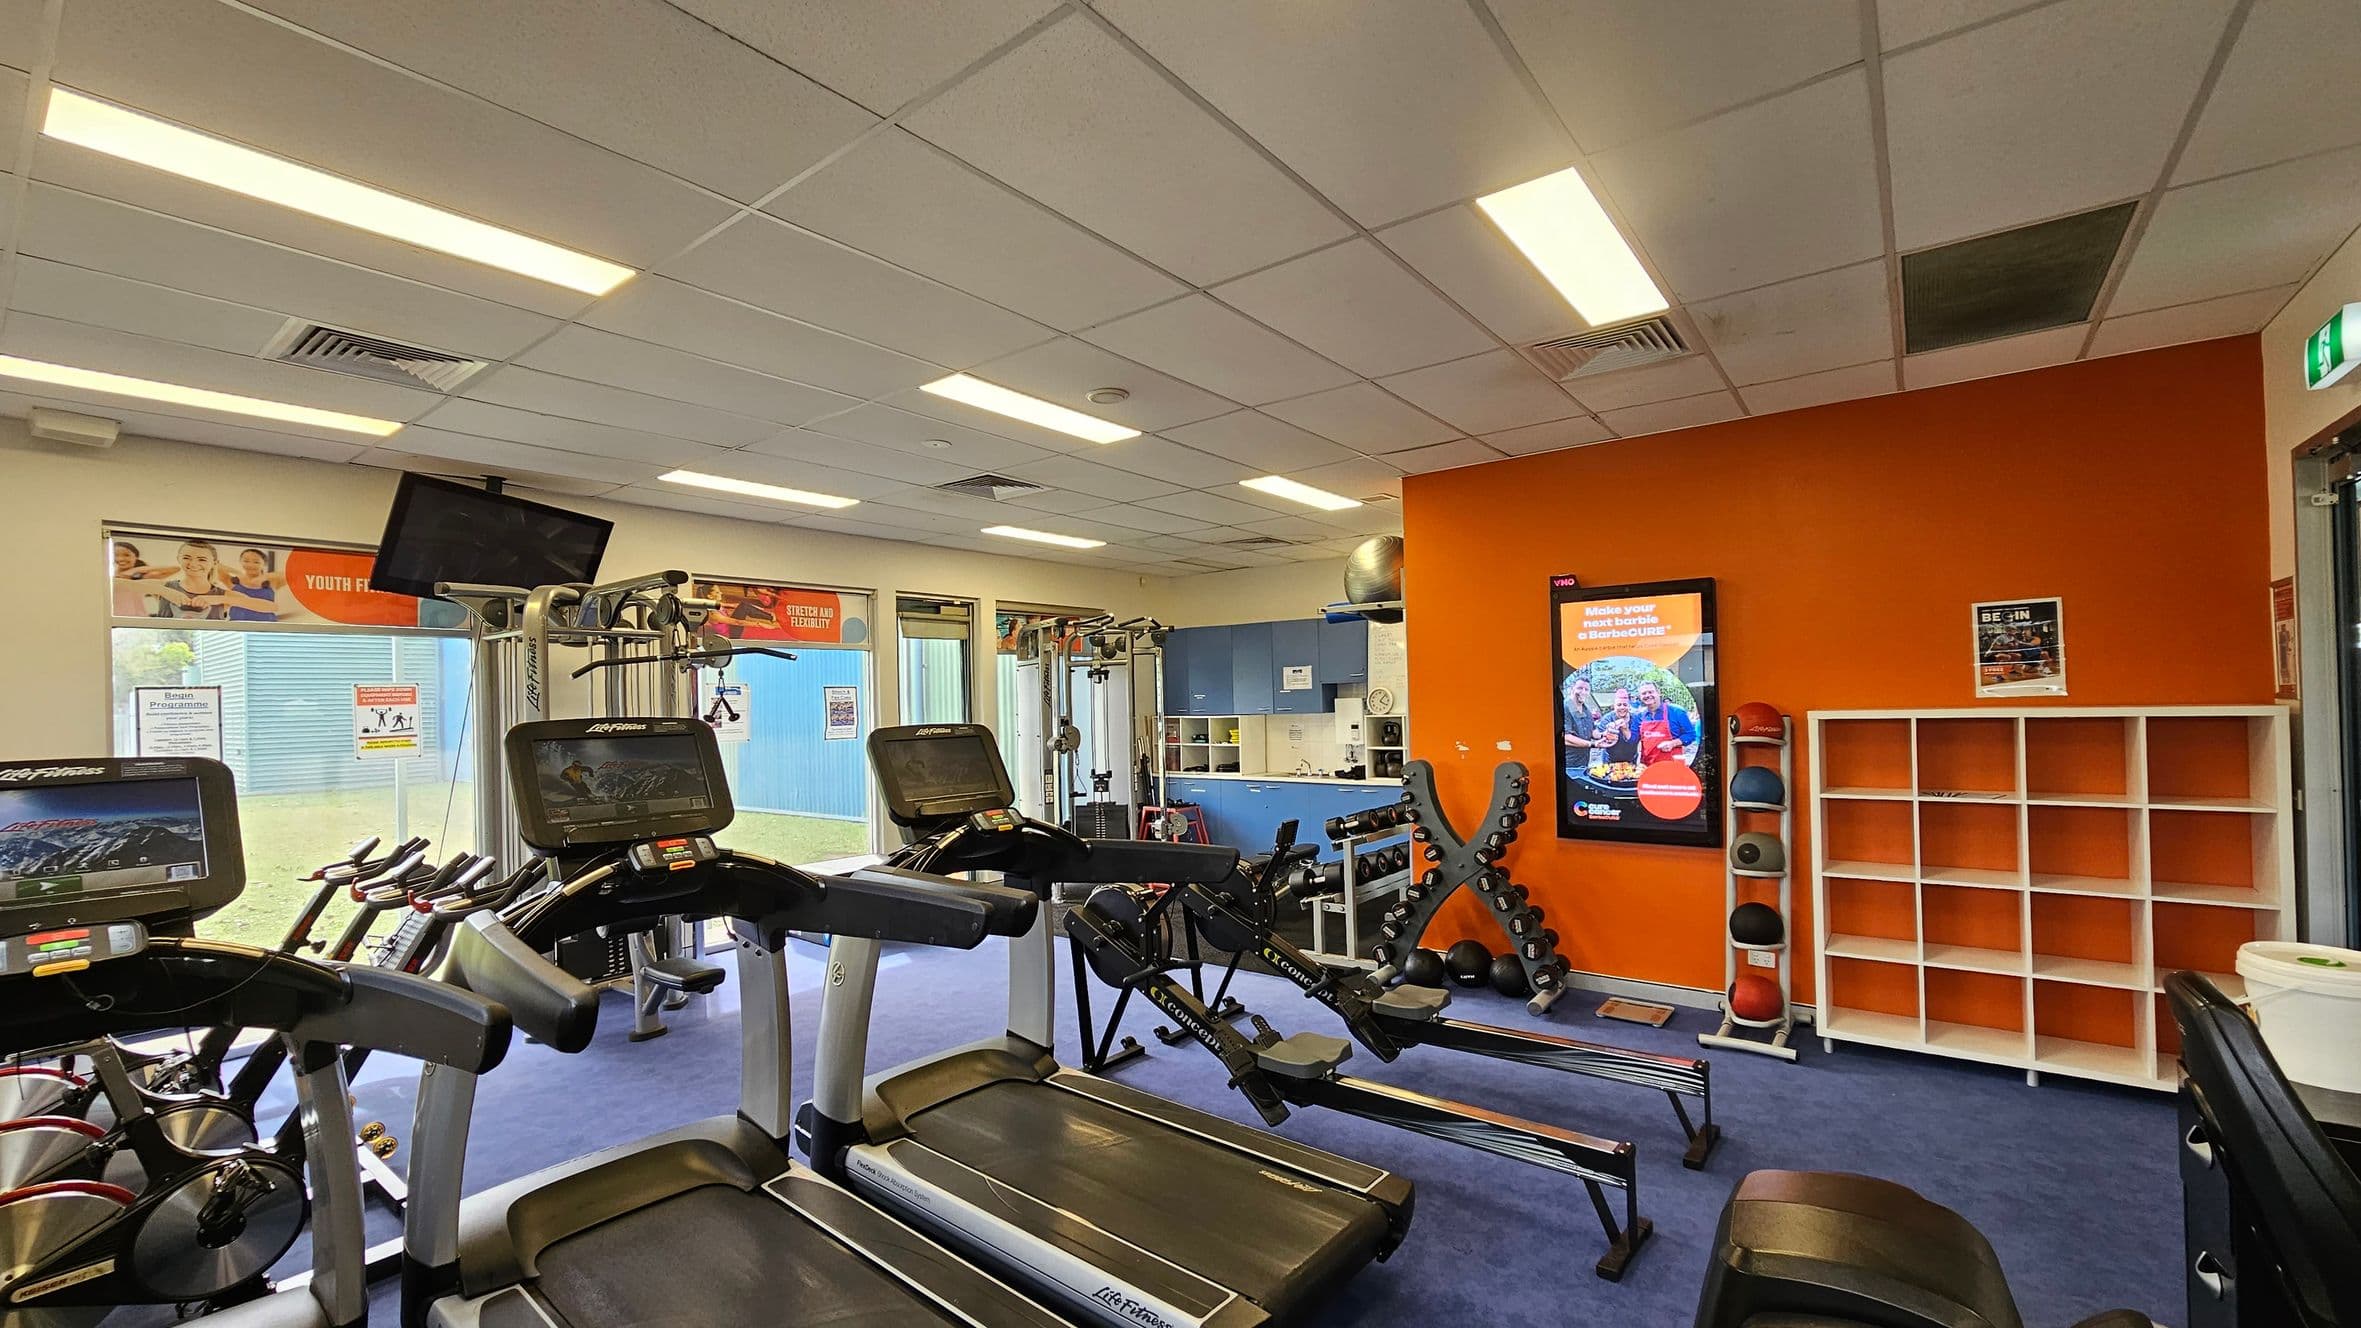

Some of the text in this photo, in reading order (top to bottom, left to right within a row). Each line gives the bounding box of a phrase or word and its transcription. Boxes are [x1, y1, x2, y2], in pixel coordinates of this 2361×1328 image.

[305, 574, 352, 592] YOUTH
[786, 604, 834, 618] STRETCH AND
[1585, 604, 1656, 616] Make your
[1583, 614, 1659, 628] next barbie
[1578, 632, 1587, 640] a
[164, 692, 194, 700] Begin
[150, 701, 209, 709] Programme
